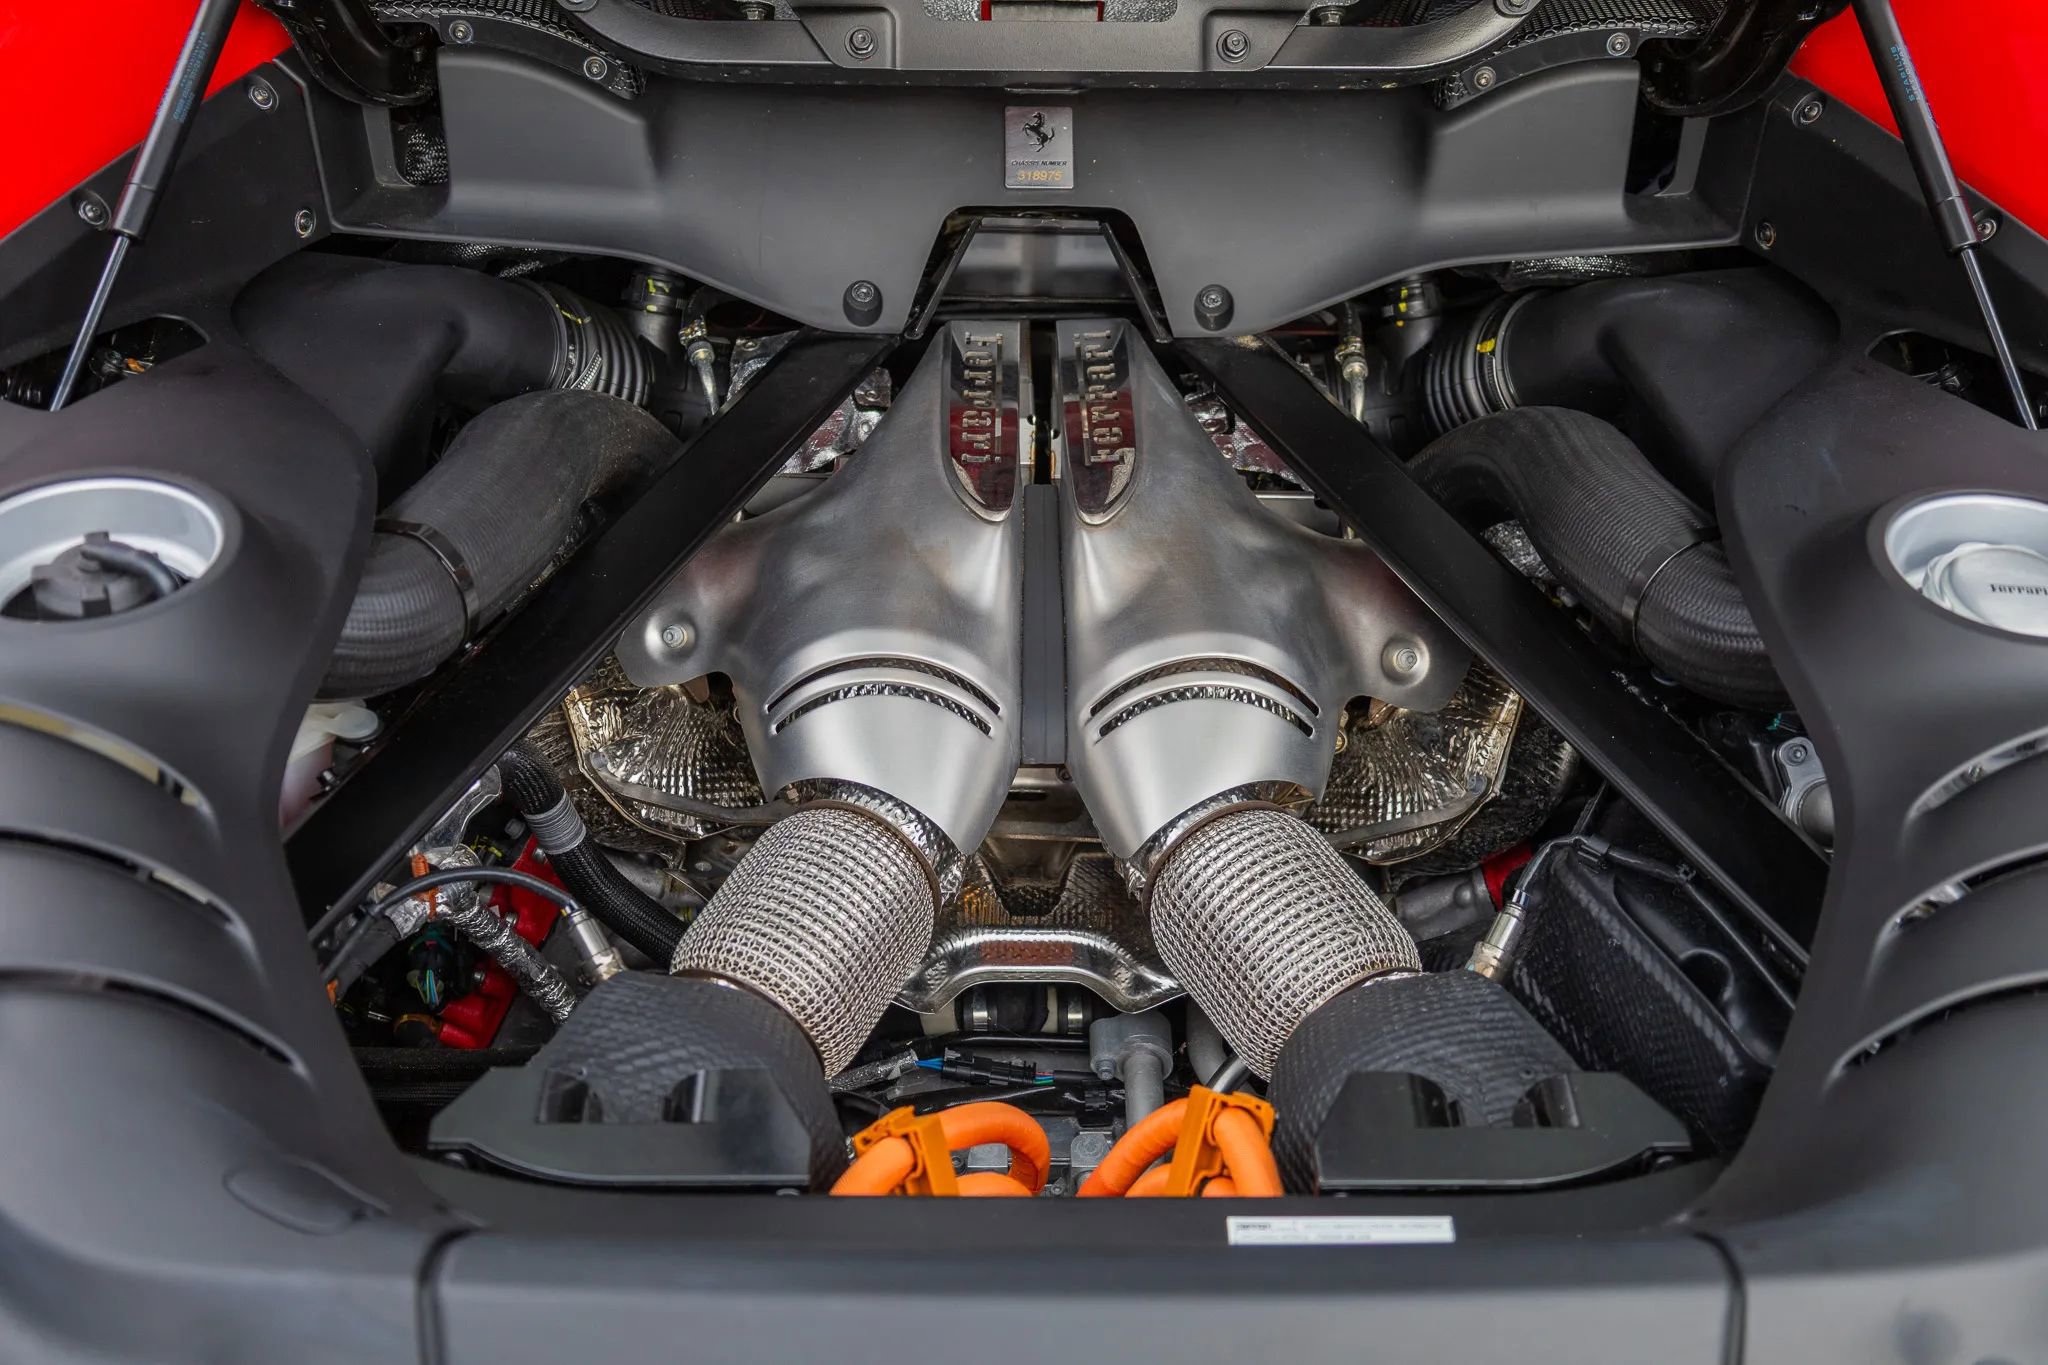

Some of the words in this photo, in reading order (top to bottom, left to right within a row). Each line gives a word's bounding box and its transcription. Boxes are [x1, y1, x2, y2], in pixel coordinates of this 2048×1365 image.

[1890, 46, 1916, 102] STABILUS
[1017, 170, 1063, 181] 318975
[961, 331, 1004, 464] Ferrari
[1073, 329, 1123, 467] Ferrari
